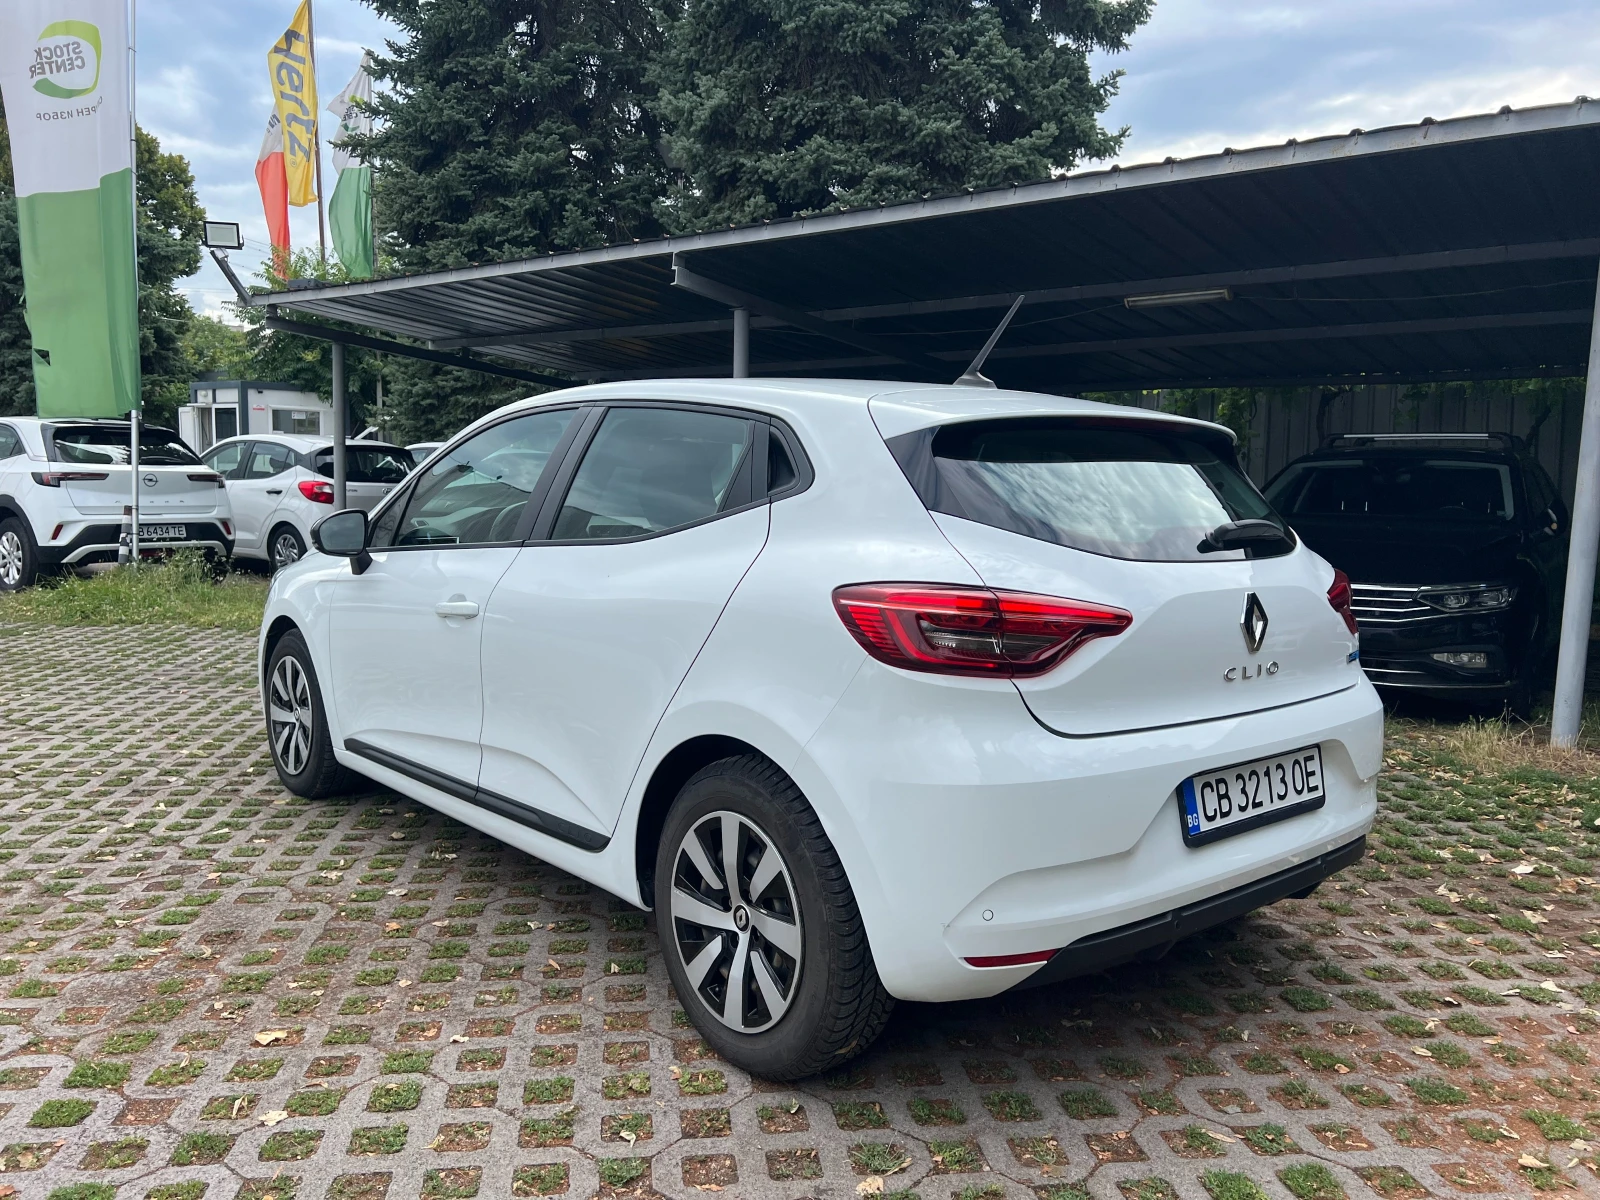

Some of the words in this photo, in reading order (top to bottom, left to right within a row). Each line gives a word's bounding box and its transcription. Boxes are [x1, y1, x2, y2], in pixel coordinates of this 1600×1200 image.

[273, 28, 316, 163] Hertz
[146, 526, 170, 537] 6434
[171, 525, 185, 536] TE
[1223, 660, 1279, 681] CLIO
[1187, 814, 1199, 828] BG
[1200, 777, 1233, 822] CB
[1235, 763, 1289, 813] 3213
[1291, 754, 1319, 796] OE
